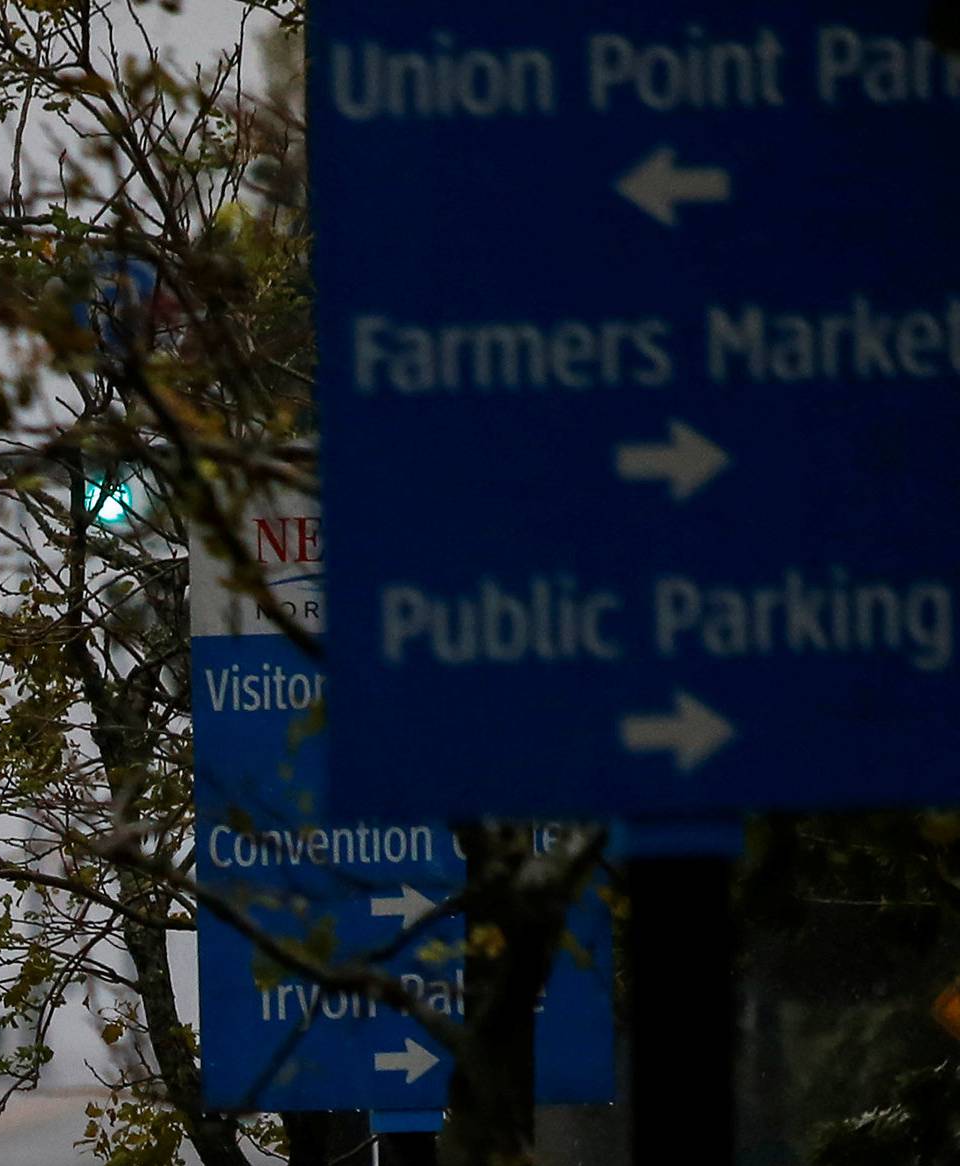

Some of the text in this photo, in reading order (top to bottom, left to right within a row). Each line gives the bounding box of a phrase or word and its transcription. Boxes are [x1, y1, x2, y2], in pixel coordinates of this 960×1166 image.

[331, 34, 555, 121] Union
[586, 26, 786, 112] Point
[352, 315, 673, 394] Farmers
[380, 570, 954, 671] Public Parking
[209, 819, 433, 868] Convention
